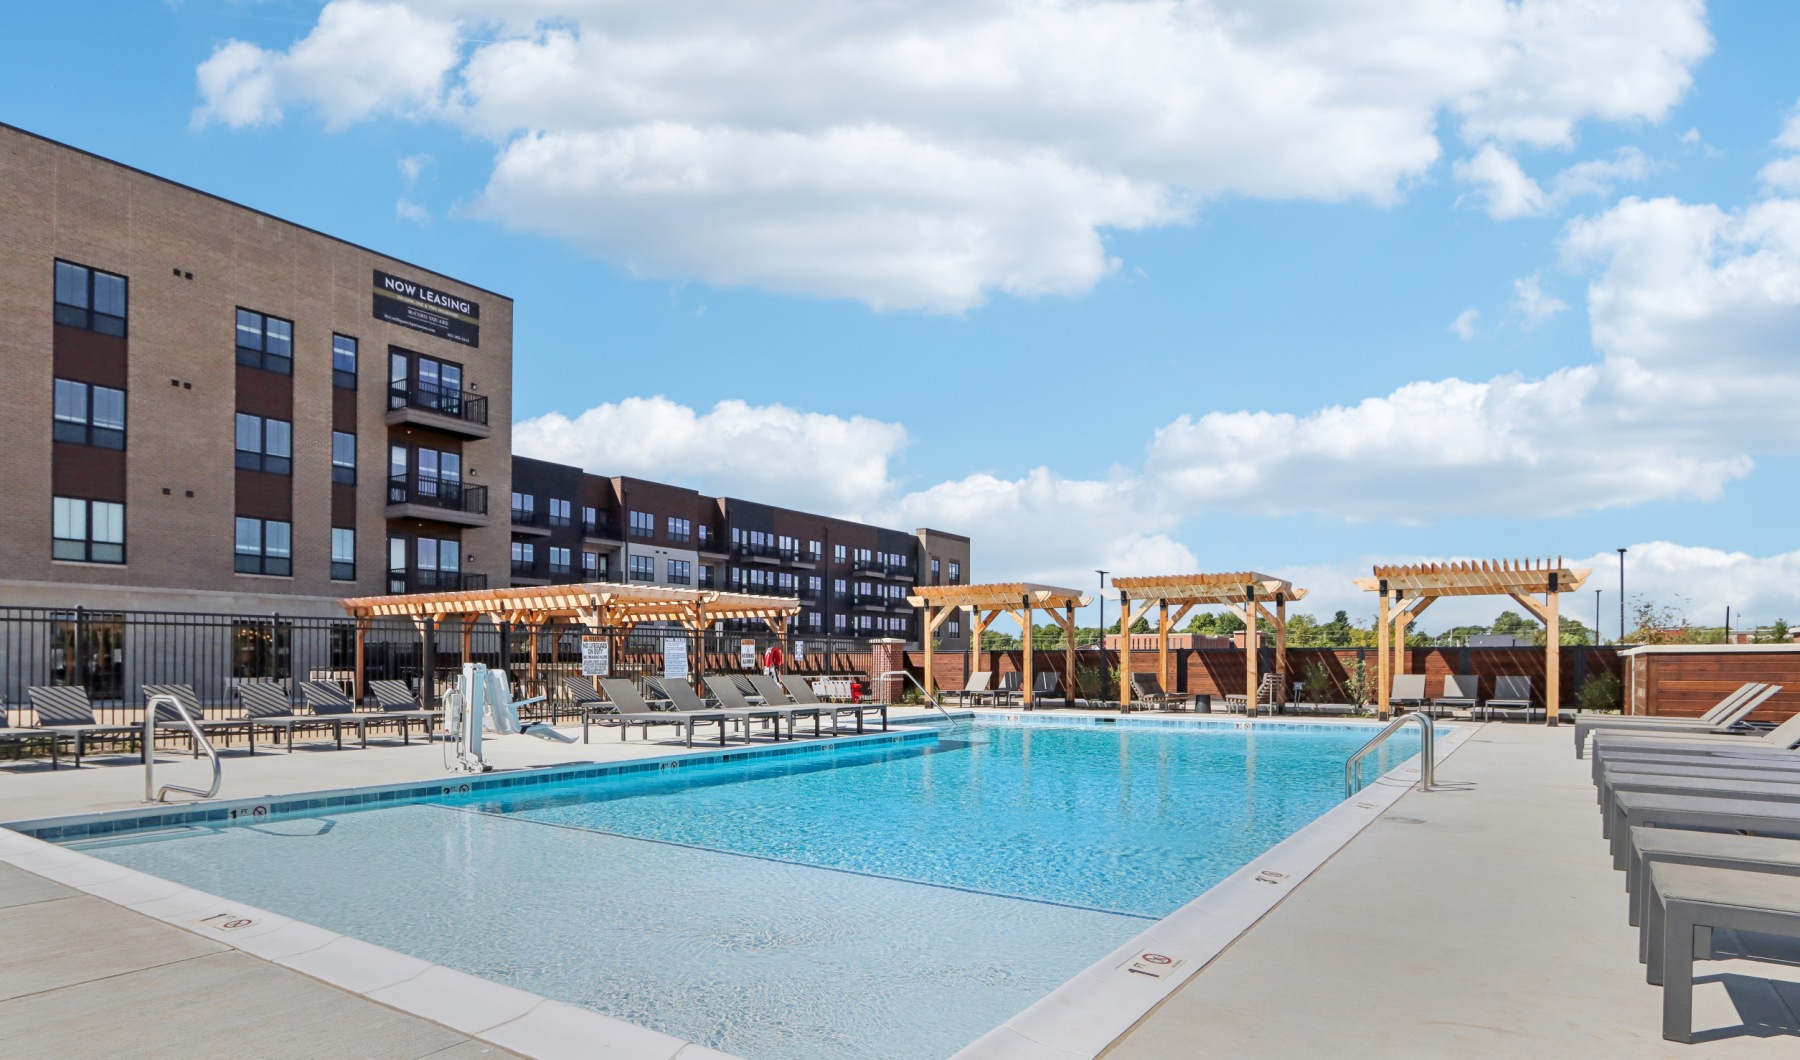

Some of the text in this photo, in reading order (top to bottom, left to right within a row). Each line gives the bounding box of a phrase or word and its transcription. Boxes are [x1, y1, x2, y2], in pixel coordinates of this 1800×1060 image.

[384, 277, 470, 314] NOW LEASING!
[428, 315, 449, 326] SQUARE
[230, 809, 237, 819] 1
[1128, 968, 1160, 978] 1
